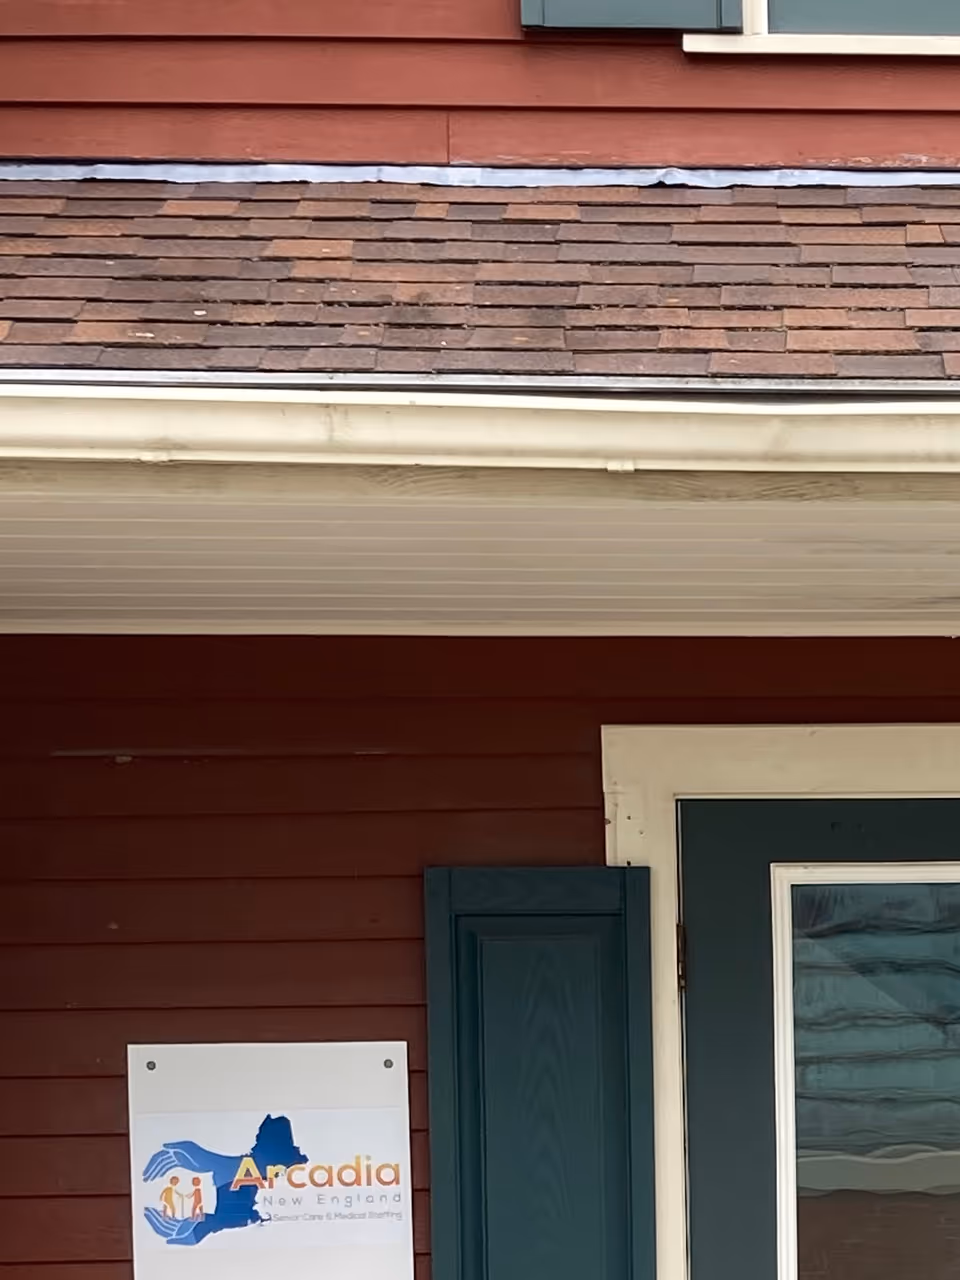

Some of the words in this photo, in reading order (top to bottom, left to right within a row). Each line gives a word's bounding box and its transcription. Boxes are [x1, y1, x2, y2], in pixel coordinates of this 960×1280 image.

[229, 1155, 401, 1191] Arcadia
[263, 1195, 303, 1206] New
[317, 1192, 402, 1209] England
